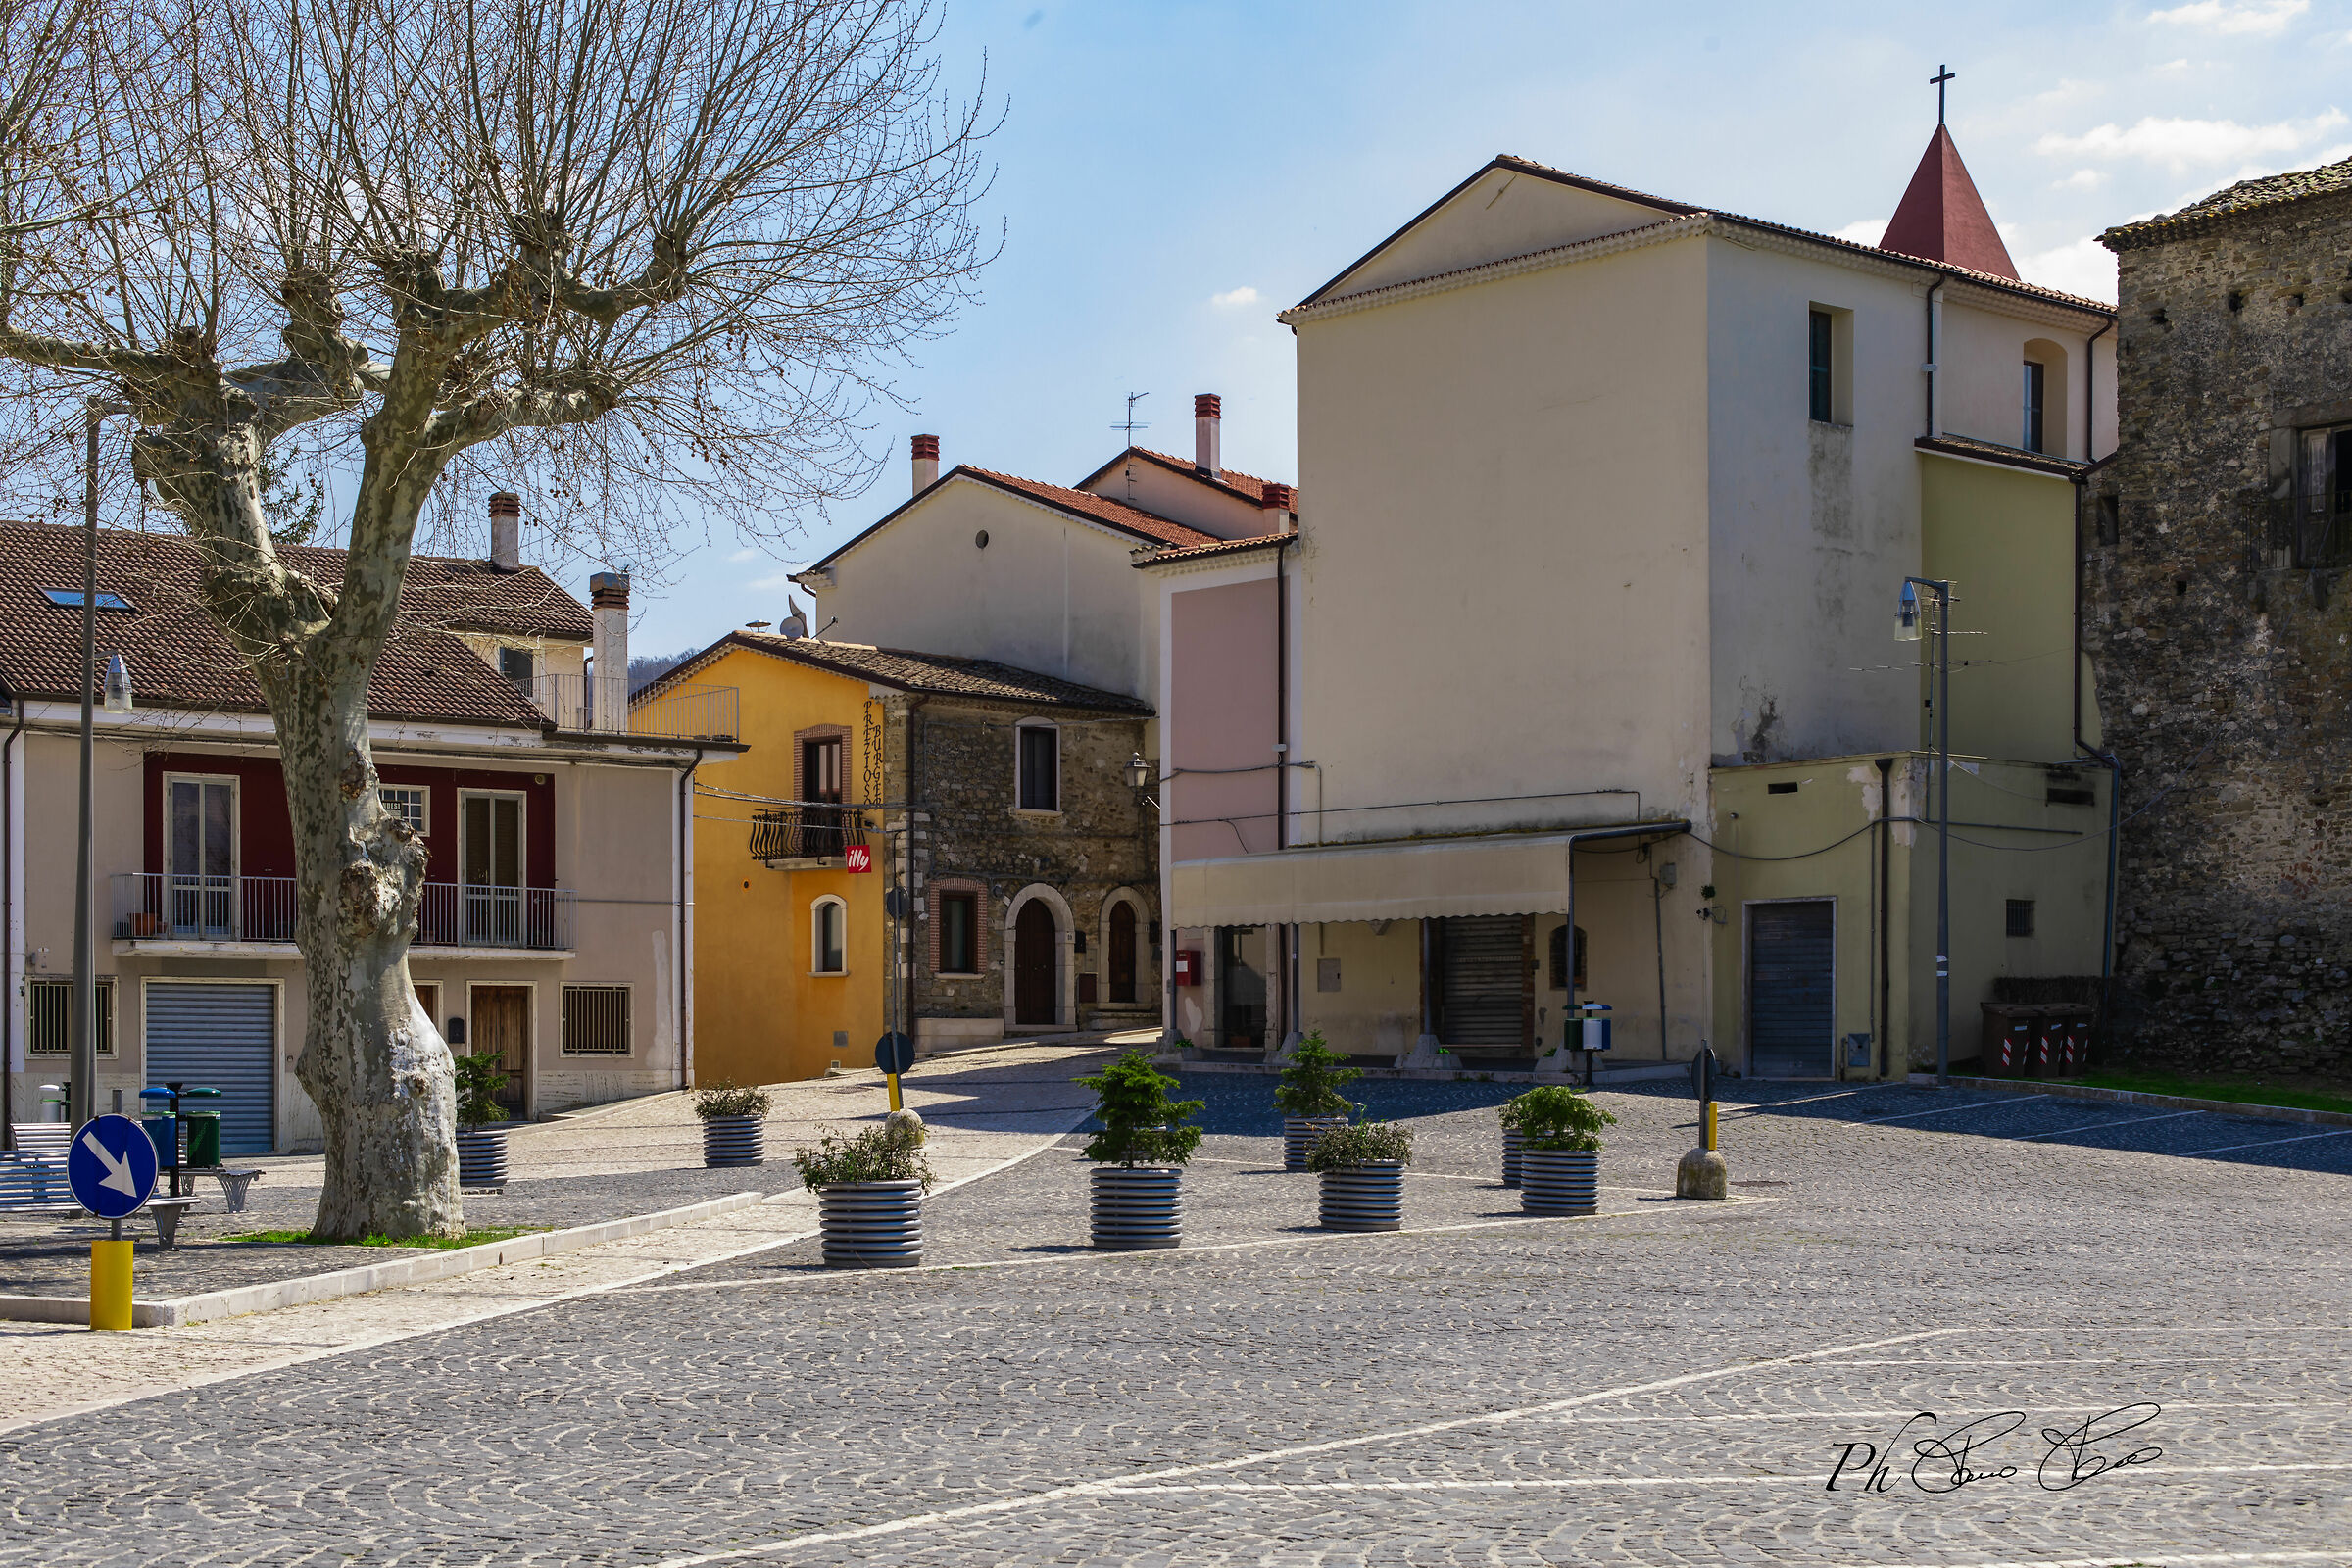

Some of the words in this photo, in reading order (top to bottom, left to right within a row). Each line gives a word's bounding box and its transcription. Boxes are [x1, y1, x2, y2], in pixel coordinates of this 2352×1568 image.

[863, 700, 873, 811] PREZIOSO
[871, 724, 883, 810] BURGER
[848, 849, 869, 872] illy
